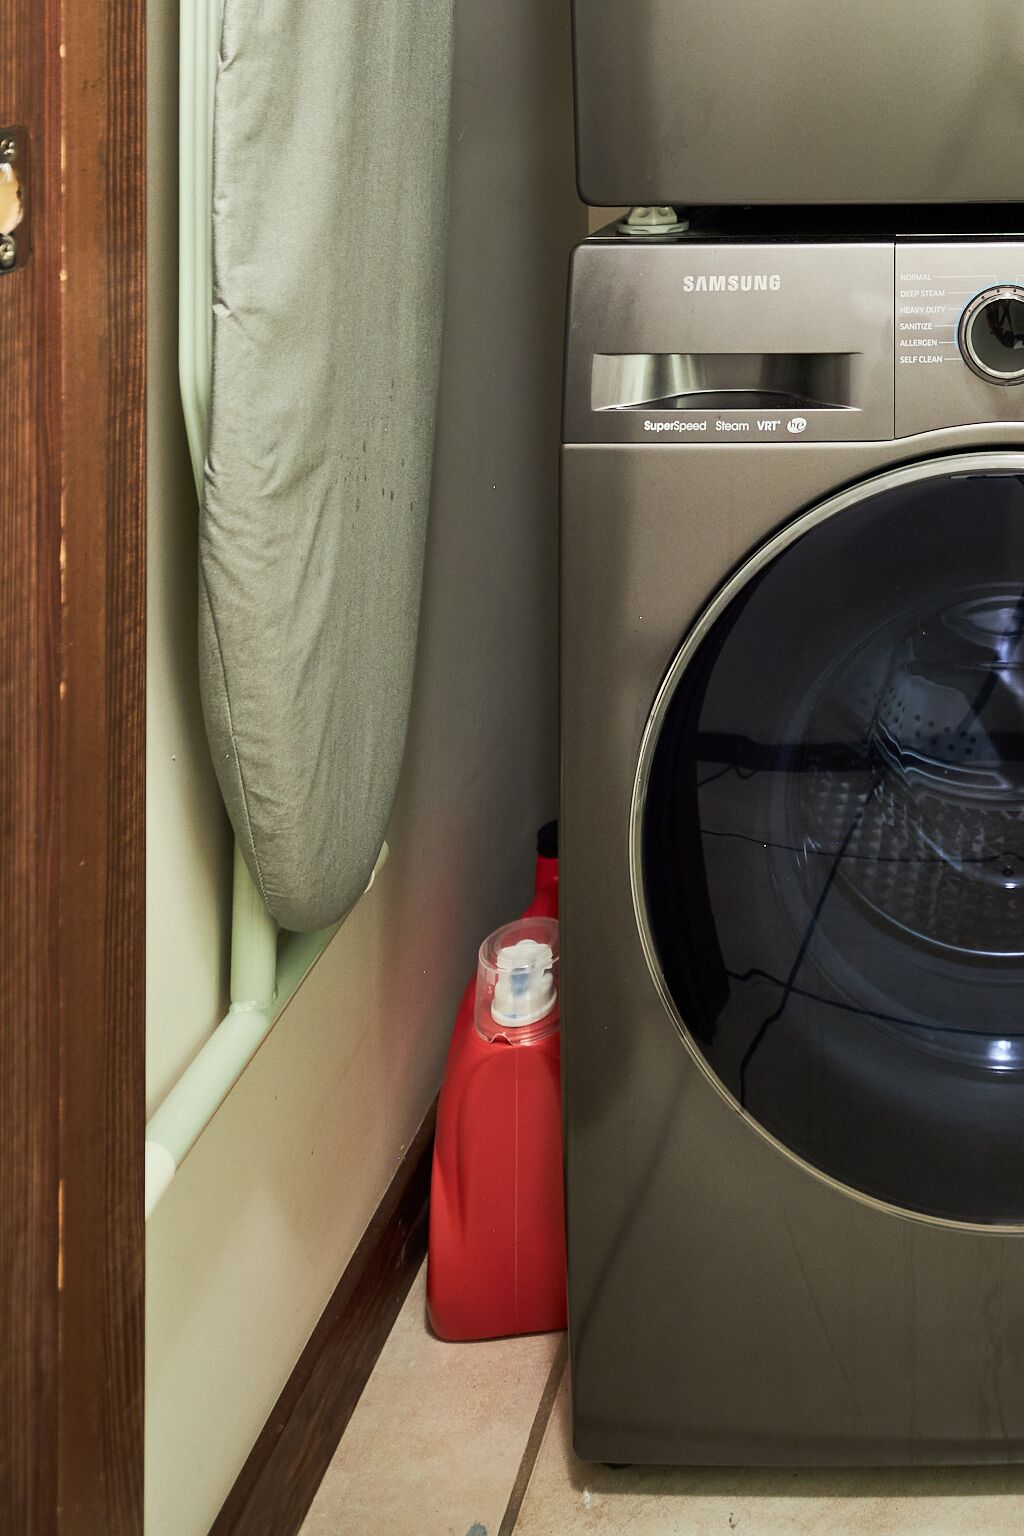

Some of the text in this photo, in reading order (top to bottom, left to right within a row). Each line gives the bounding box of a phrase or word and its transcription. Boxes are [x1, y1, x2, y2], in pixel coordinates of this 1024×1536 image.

[683, 274, 781, 292] SAMSUNG
[900, 290, 919, 298] DEEP
[900, 306, 925, 314] HEAVY
[900, 322, 933, 330] SANITIZE
[900, 339, 938, 347] ALLERGEN
[900, 355, 943, 364] SELF CLEAN
[644, 420, 707, 432] SuperSpeed
[715, 420, 750, 431] Steam
